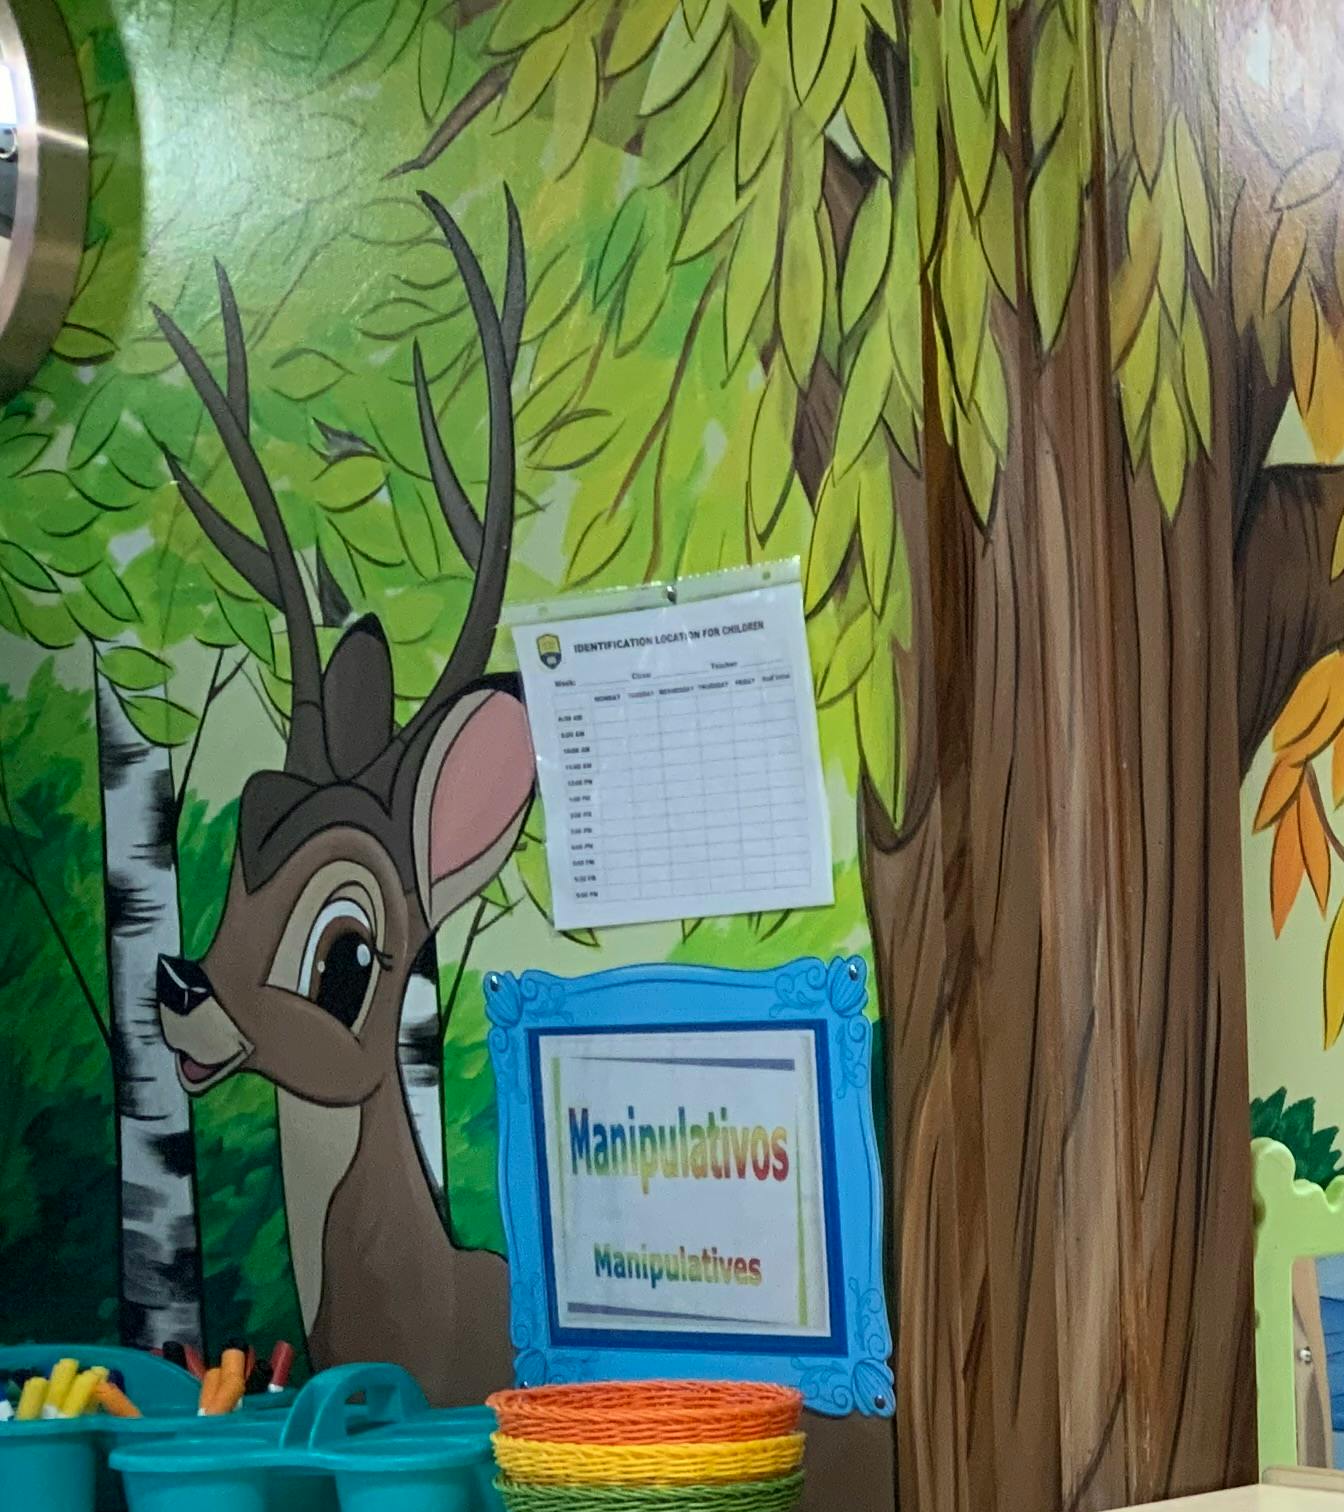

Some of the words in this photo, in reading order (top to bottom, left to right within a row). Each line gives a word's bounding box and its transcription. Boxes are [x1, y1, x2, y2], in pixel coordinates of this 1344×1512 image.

[573, 636, 654, 654] IDENTIFICATION
[702, 627, 721, 639] FOR
[722, 620, 765, 636] CHILDREN
[568, 1106, 790, 1195] Manipulativos
[593, 1242, 763, 1289] Manipulatives
